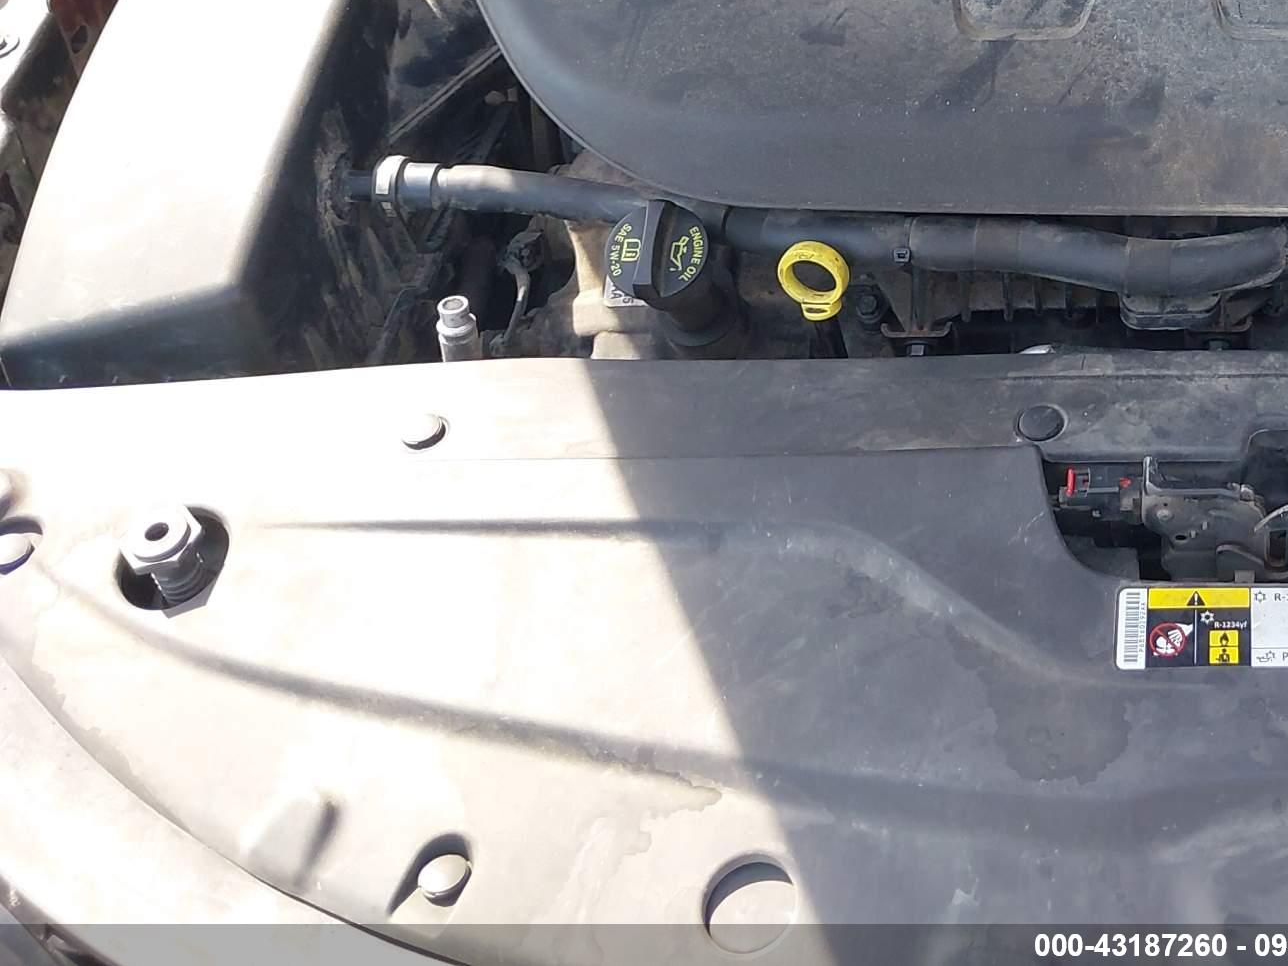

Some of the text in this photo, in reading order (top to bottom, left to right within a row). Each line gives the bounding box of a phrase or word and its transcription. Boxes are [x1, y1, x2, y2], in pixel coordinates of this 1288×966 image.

[608, 223, 633, 277] SAE 5W-20
[677, 225, 704, 282] ENGINE OIL
[1213, 620, 1248, 630] R-1234yf
